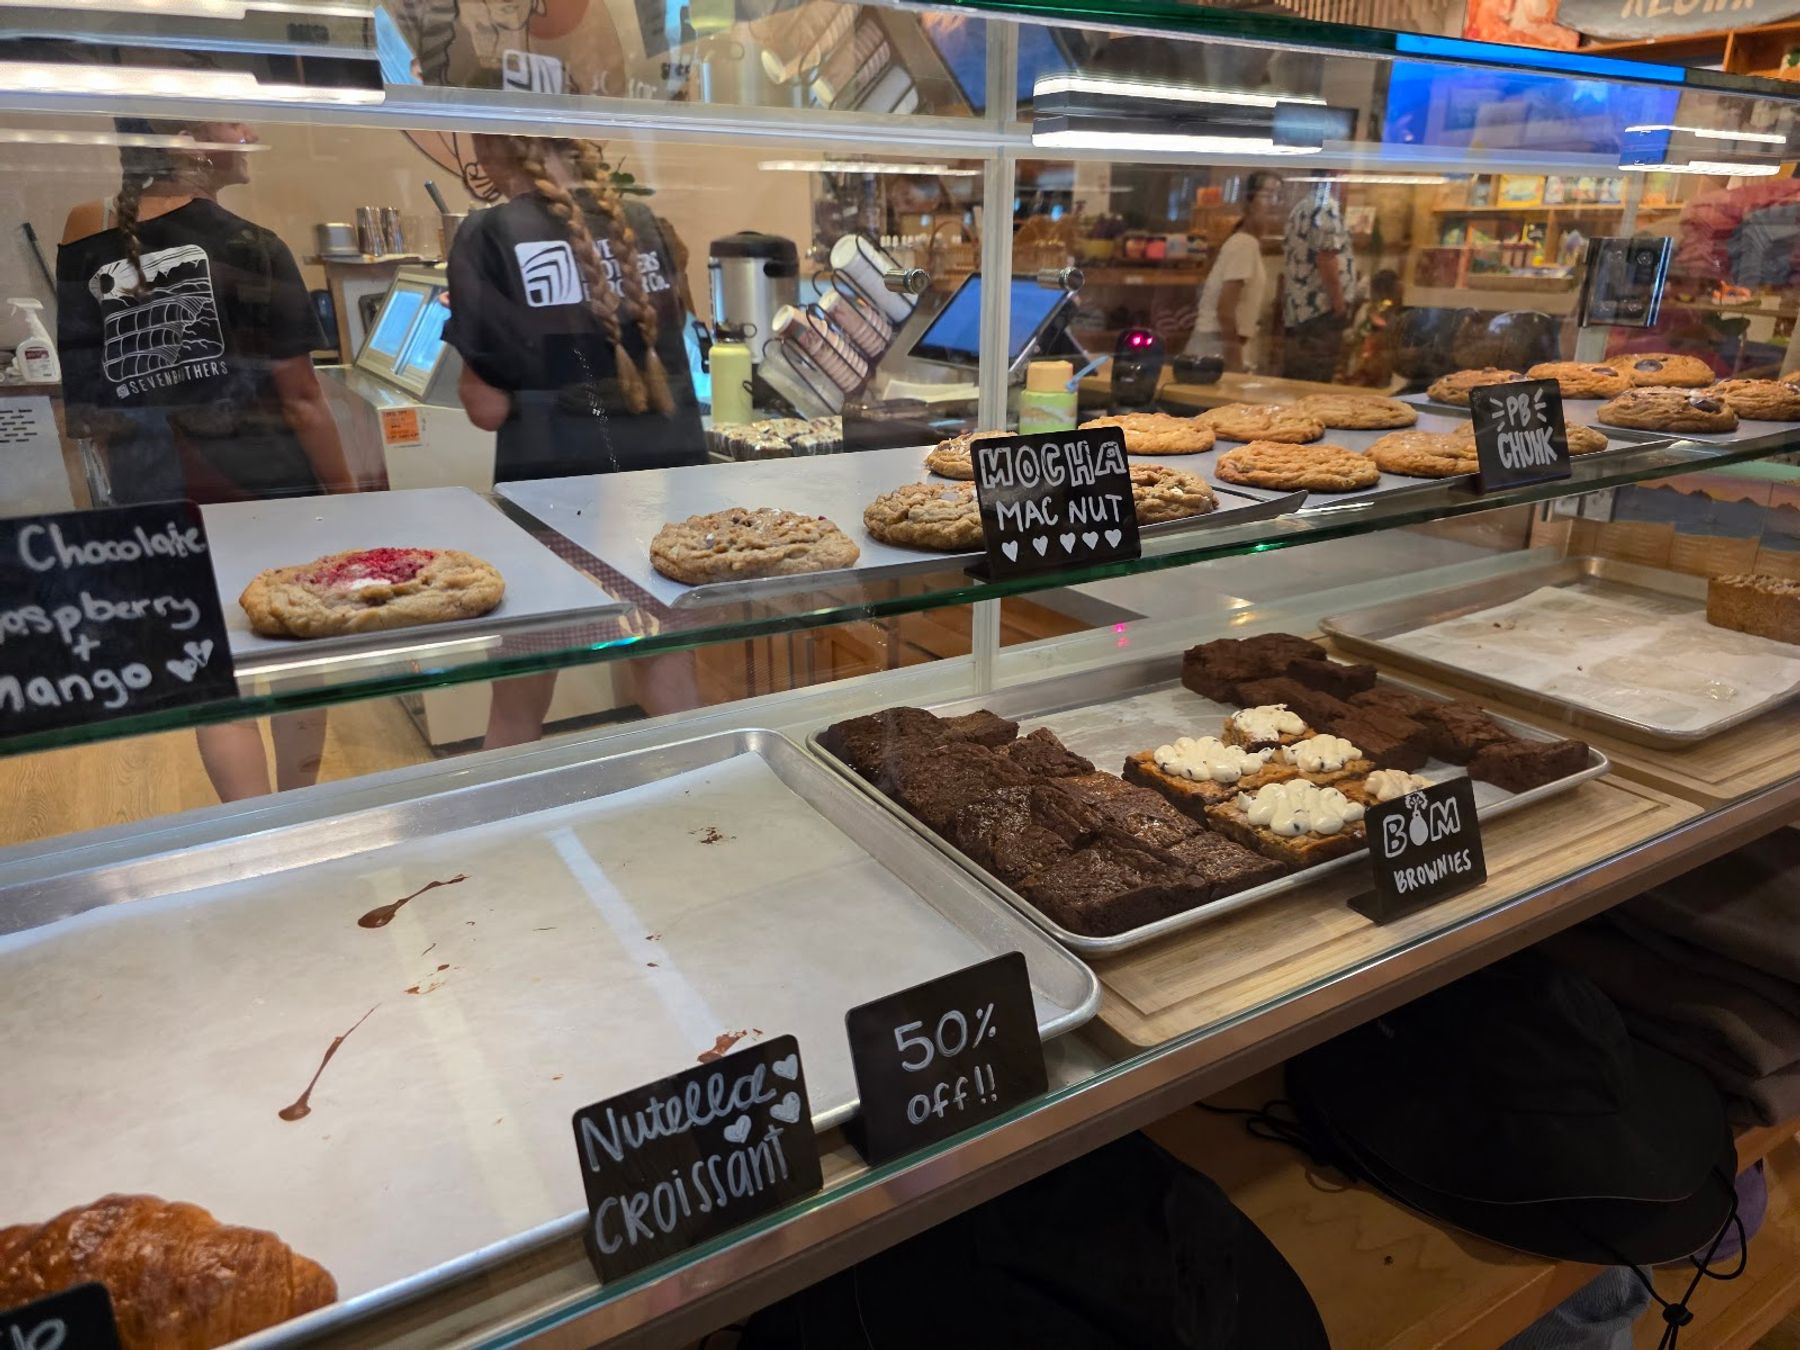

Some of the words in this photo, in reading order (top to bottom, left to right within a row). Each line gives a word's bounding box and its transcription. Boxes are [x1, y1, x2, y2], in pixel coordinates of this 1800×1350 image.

[1506, 393, 1531, 427] PB
[979, 440, 1127, 489] MOCHA
[1498, 426, 1558, 469] CHUNK
[996, 496, 1059, 532] MAC
[1068, 494, 1123, 524] NUT
[19, 521, 207, 572] Chocolate
[0, 591, 200, 644] aspberry
[1394, 849, 1472, 894] BROWNIES
[894, 1003, 997, 1072] 50%
[581, 1063, 777, 1172] Nutella
